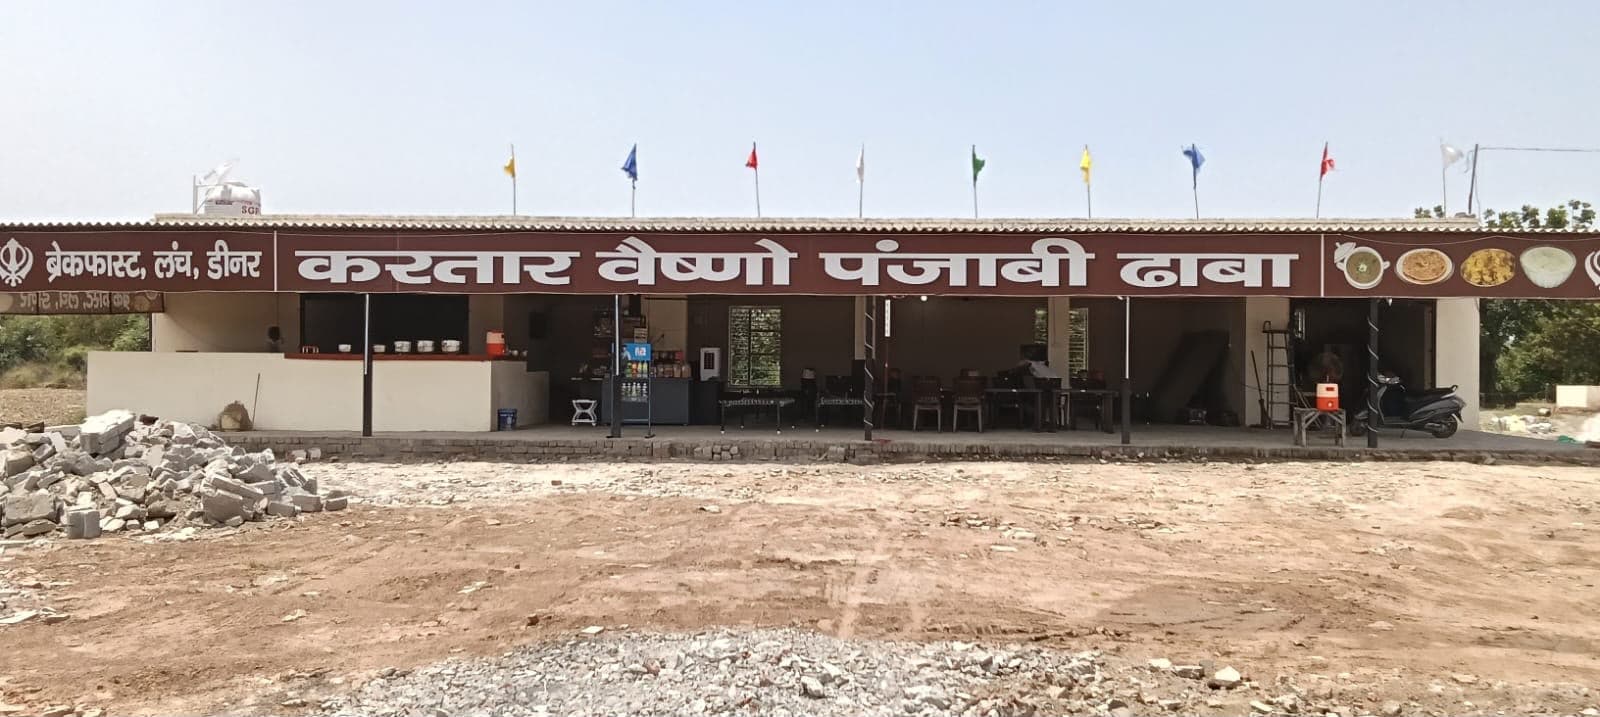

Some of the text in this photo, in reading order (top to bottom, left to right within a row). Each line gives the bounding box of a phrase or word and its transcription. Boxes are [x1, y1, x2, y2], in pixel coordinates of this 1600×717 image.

[45, 239, 263, 283] ब्रेकफास्ट, लंच, डीनर
[294, 236, 1299, 288] करतार वैष्णो पंजाबी ढाबा
